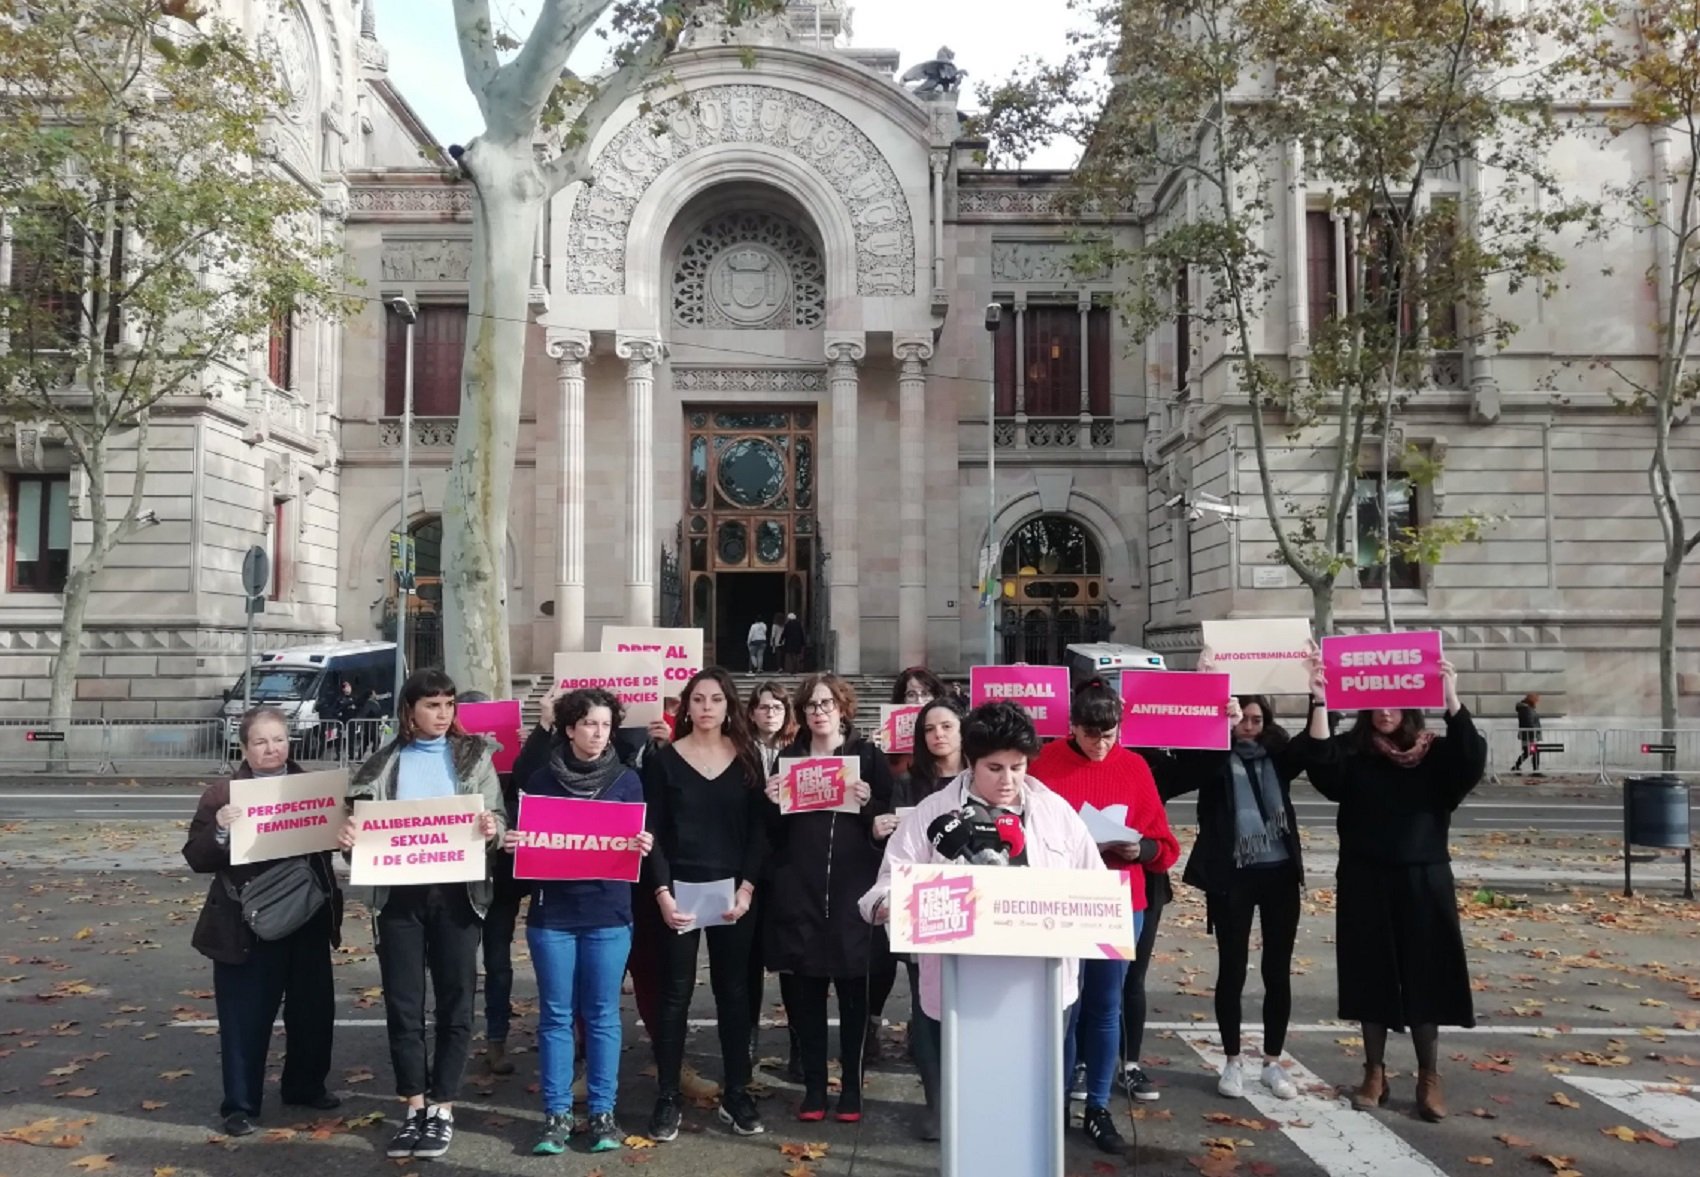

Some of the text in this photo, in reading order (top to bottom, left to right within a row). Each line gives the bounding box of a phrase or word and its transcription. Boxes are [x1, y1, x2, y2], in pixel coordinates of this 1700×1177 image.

[665, 646, 688, 659] AL
[1341, 648, 1423, 667] SERVEIS
[560, 676, 658, 689] ABORDATGE DE
[1341, 670, 1426, 692] PÚBLICS
[983, 683, 1056, 698] TREBALL
[1130, 703, 1219, 717] ANTIFEIXISME
[247, 796, 336, 817] PERSPECTIVA
[256, 815, 328, 834] FEMINISTA
[362, 813, 475, 831] ALLIBERAMENT
[390, 832, 449, 847] SEXUAL
[518, 831, 641, 852] HABITATGE
[372, 849, 465, 866] I DE GÈNERE
[919, 898, 961, 920] NISME
[993, 899, 1123, 918] #DECIDIMFEMINISME
